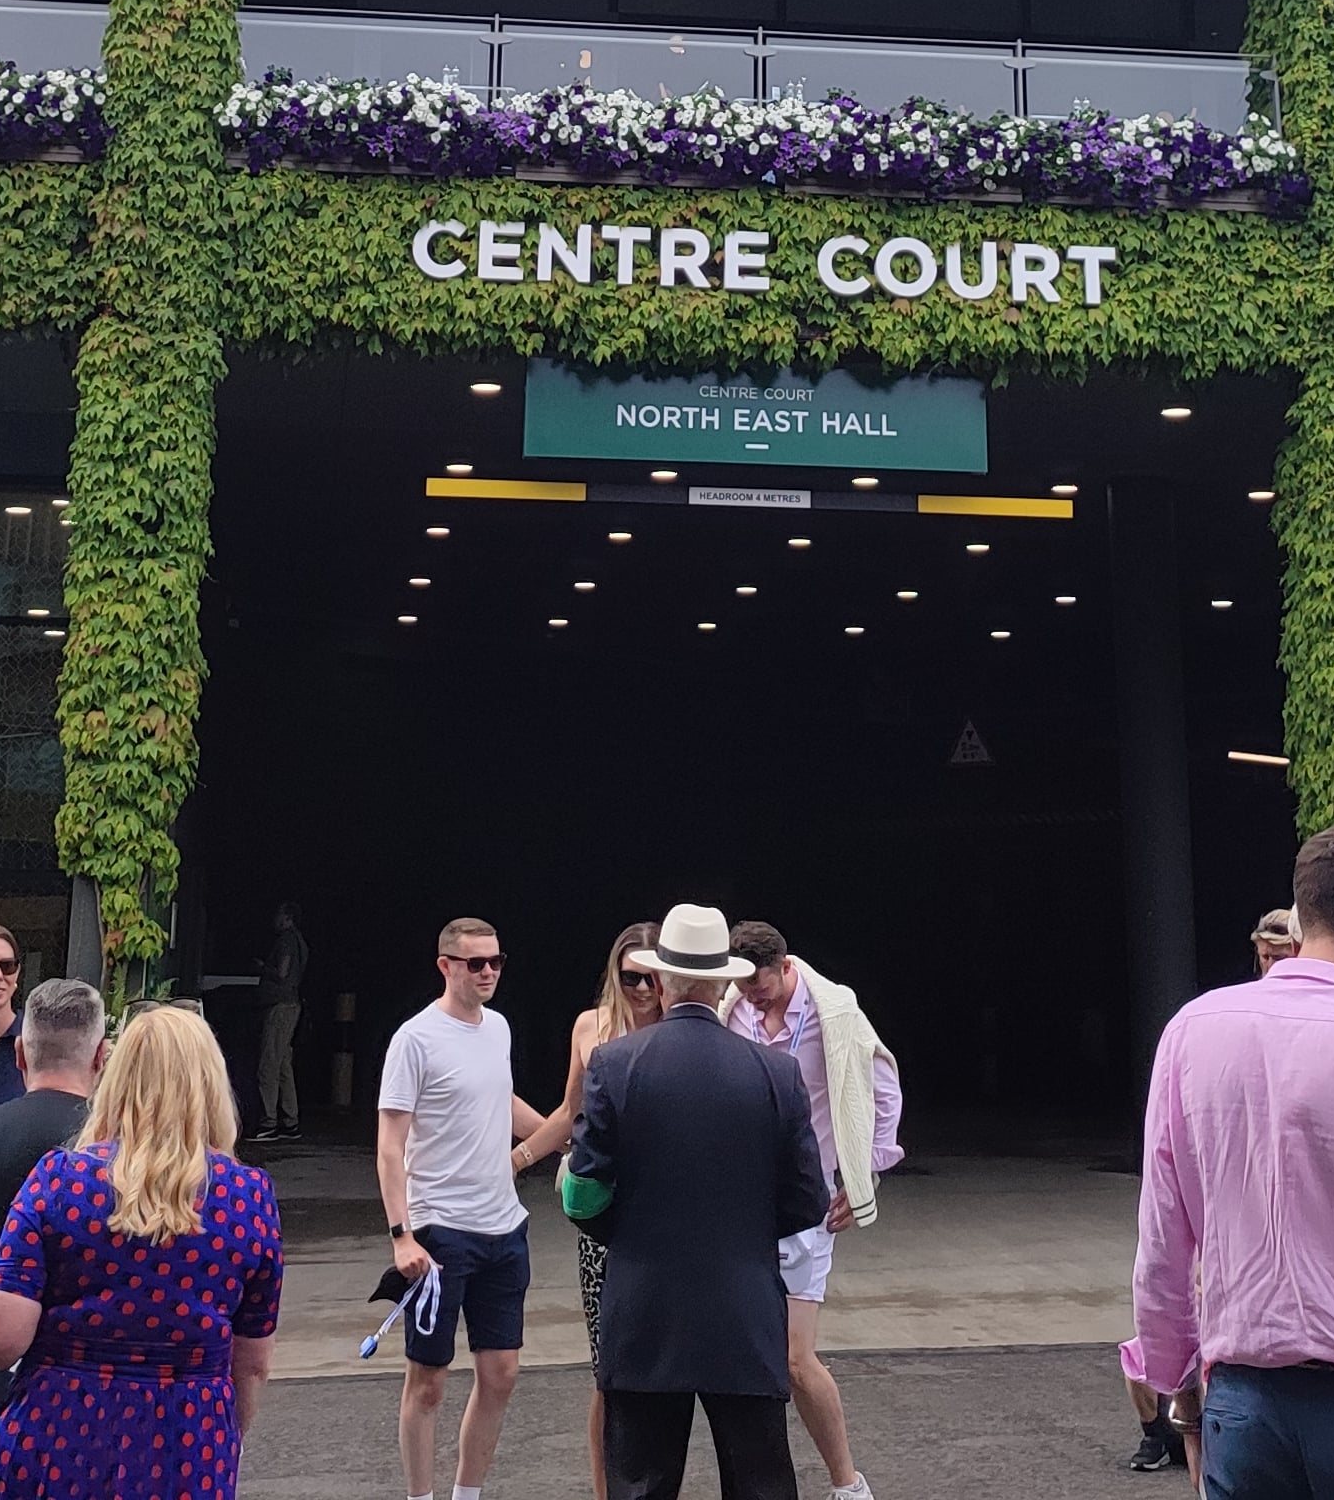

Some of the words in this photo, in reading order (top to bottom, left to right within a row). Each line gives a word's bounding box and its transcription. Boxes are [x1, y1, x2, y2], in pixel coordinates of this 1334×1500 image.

[412, 219, 770, 292] CENTRE
[817, 236, 1116, 305] COURT
[699, 385, 758, 400] CENTRE
[764, 387, 815, 401] COURT
[616, 404, 720, 431] NORTH
[733, 408, 809, 433] EAST
[821, 411, 898, 437] HALL
[699, 491, 754, 501] HEADROOM
[755, 493, 761, 501] 4
[763, 494, 801, 503] METRES
